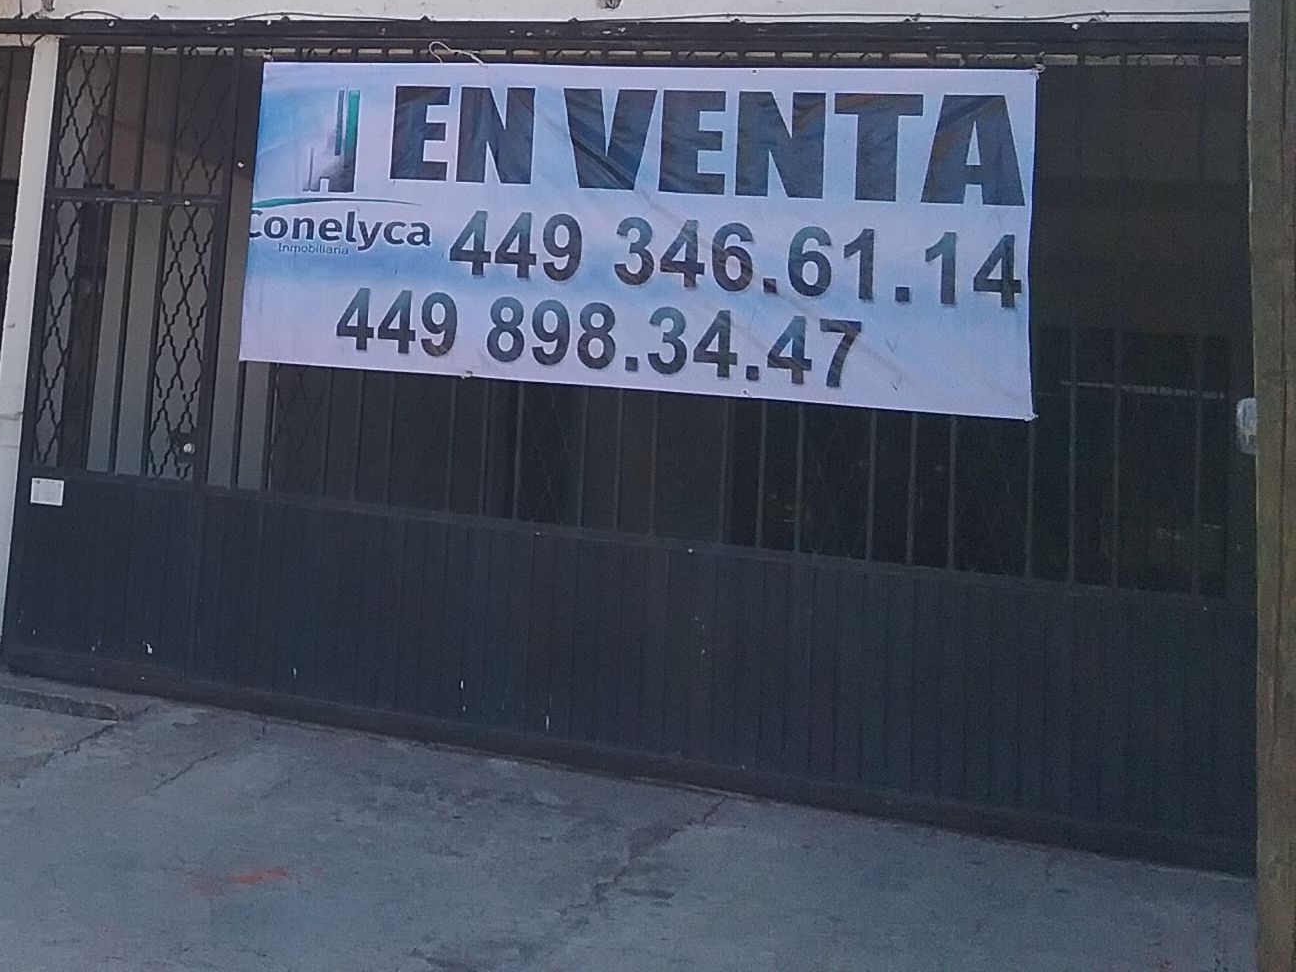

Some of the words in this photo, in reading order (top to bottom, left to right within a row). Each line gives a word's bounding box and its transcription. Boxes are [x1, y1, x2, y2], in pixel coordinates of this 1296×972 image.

[389, 85, 536, 185] EN
[563, 87, 1026, 206] VENTA
[277, 242, 350, 256] Inmobiliaria
[449, 210, 583, 282] 449
[613, 216, 1023, 309] 346.61.14
[336, 287, 458, 357] 449
[486, 296, 863, 388] 898.34.47
